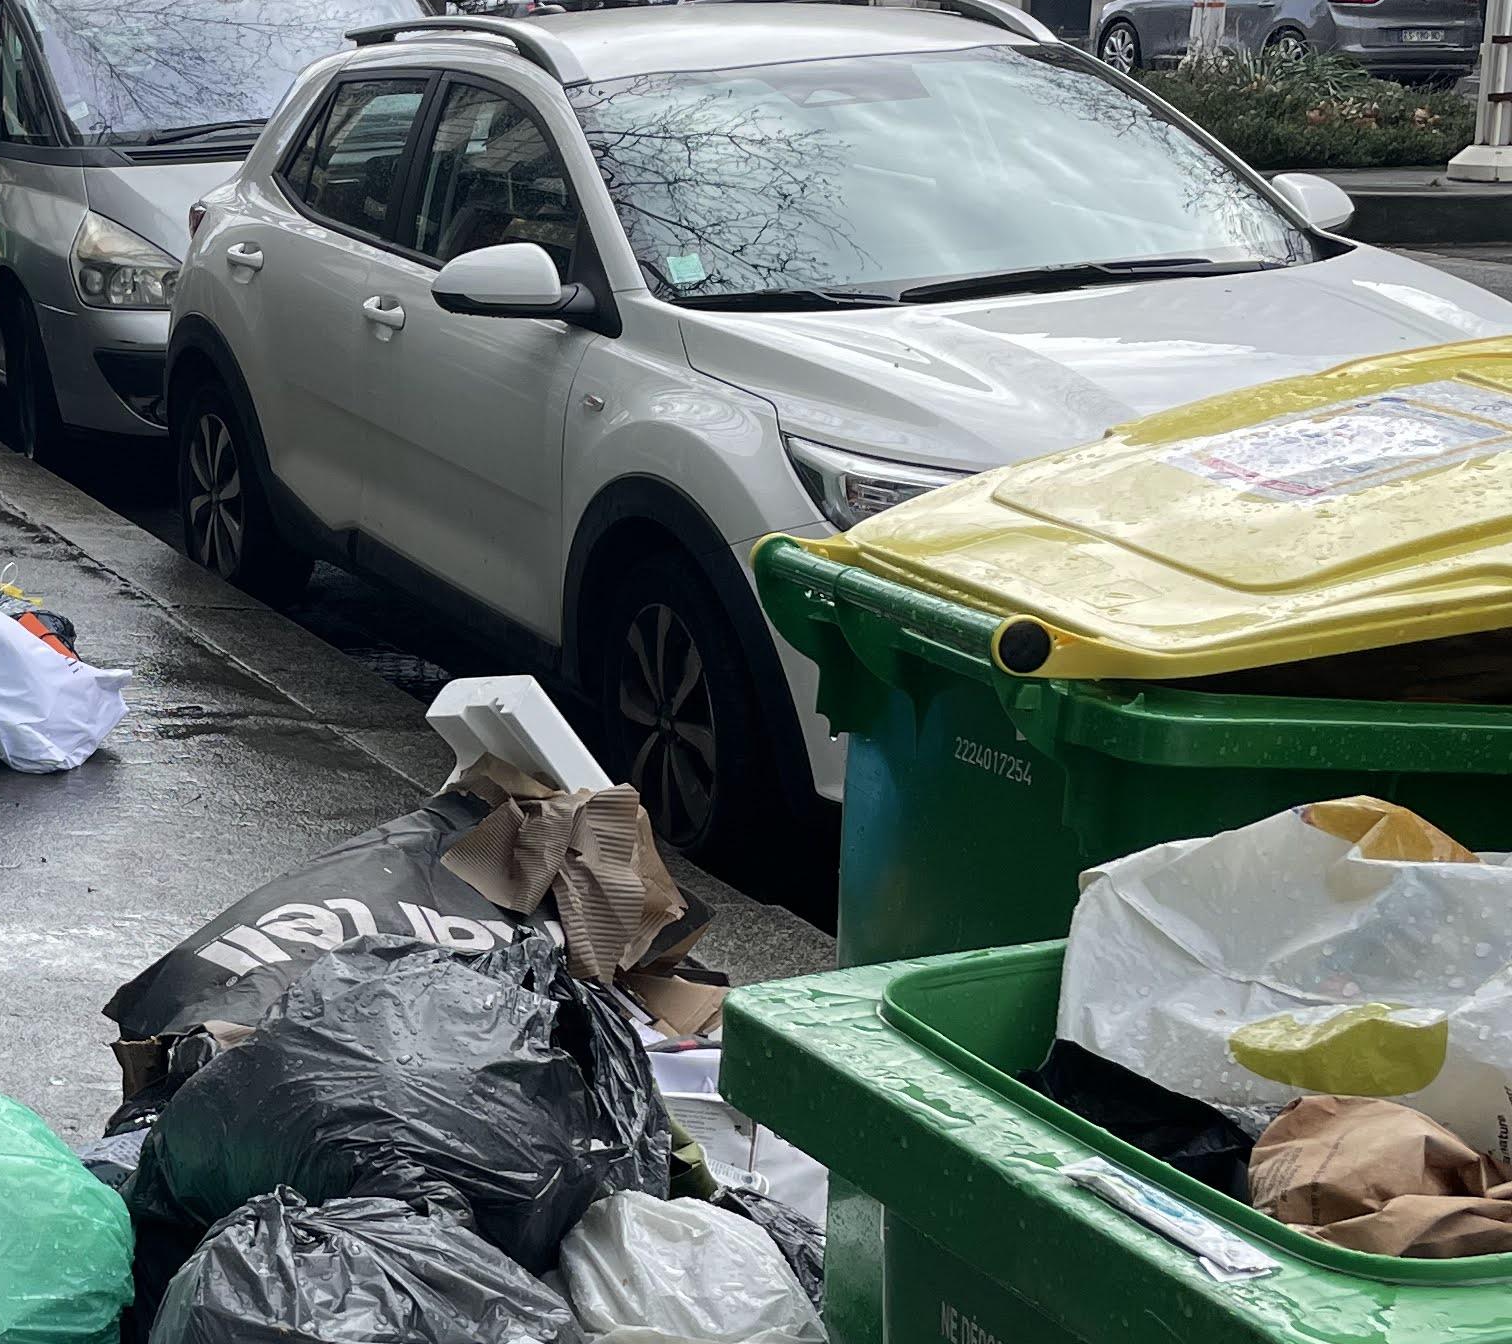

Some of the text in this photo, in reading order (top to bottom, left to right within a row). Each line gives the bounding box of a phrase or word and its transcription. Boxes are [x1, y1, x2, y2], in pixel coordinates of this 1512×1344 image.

[954, 736, 1032, 786] 2224017254
[197, 898, 566, 977] artell
[941, 1300, 958, 1344] NE
